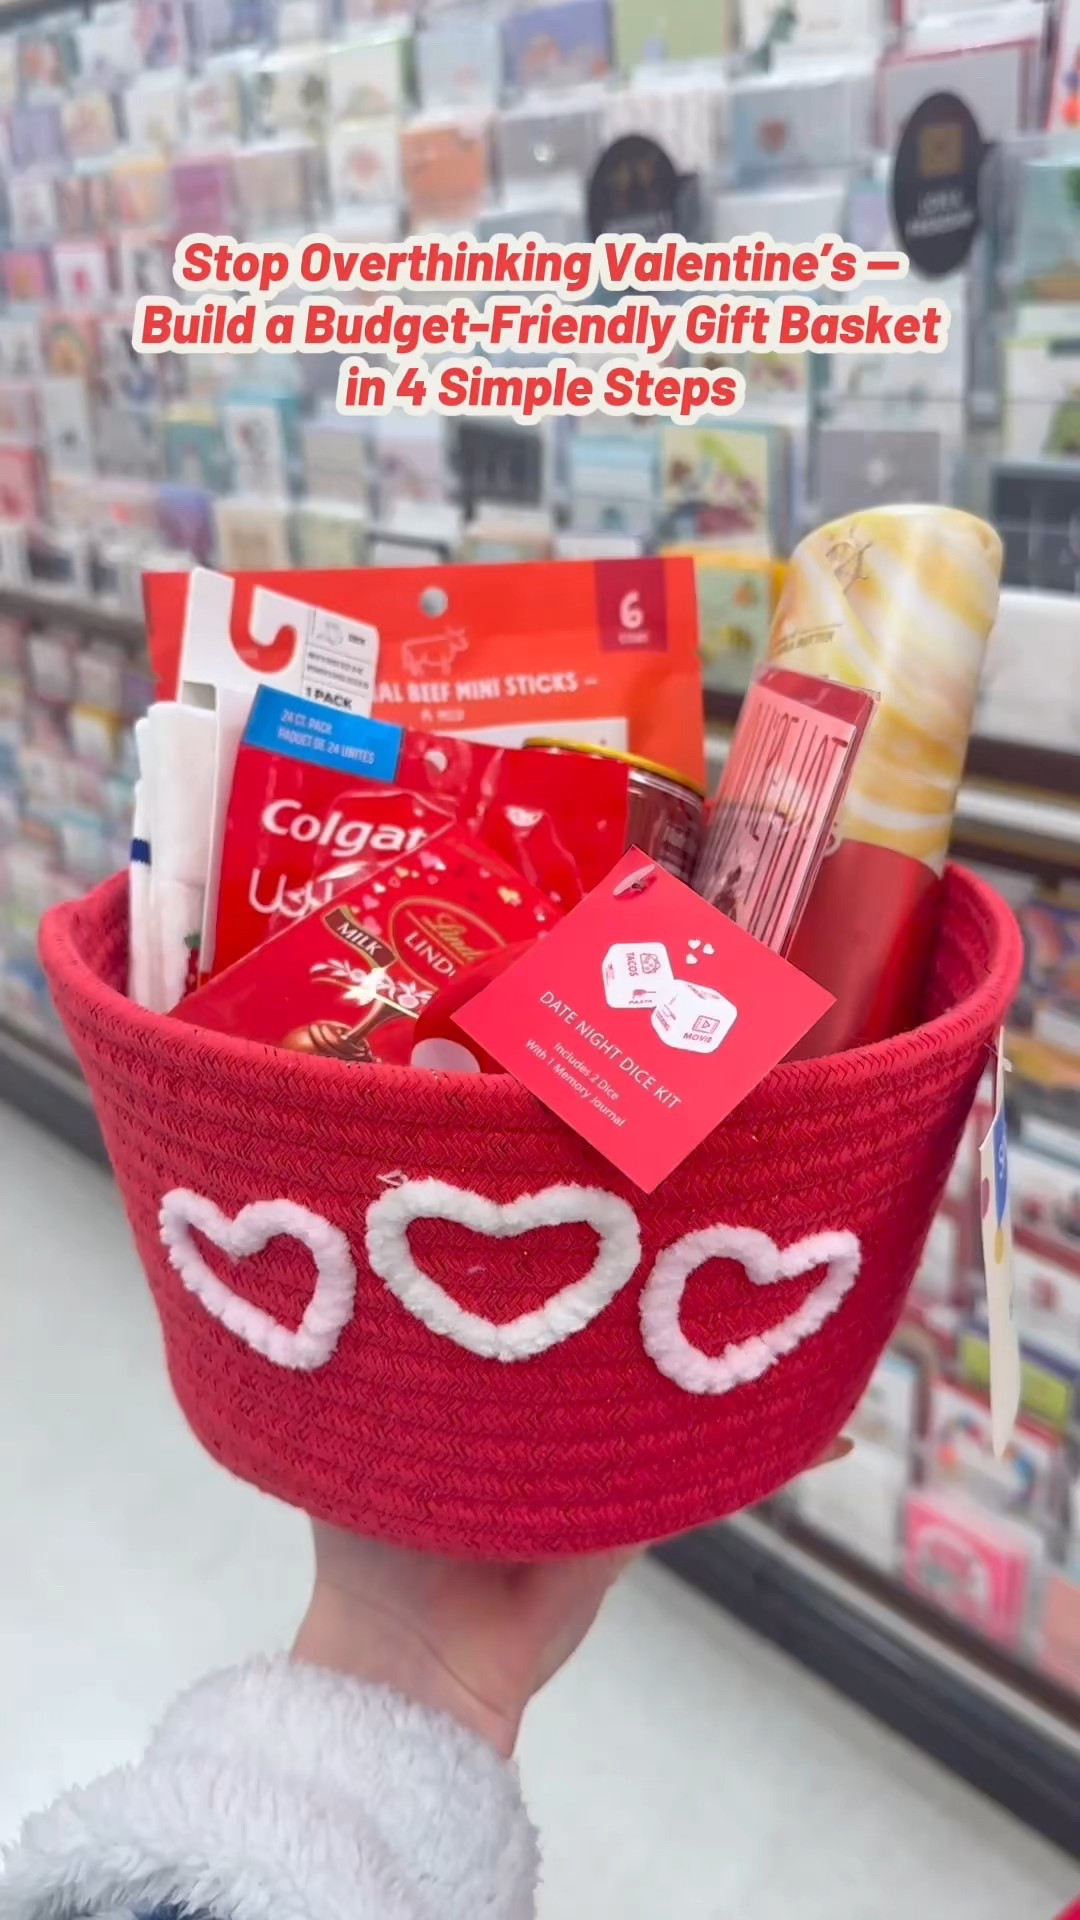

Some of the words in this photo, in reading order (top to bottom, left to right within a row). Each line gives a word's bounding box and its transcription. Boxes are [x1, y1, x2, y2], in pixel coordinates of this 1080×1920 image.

[619, 589, 644, 629] 6
[315, 688, 353, 711] PACK
[407, 681, 450, 704] BEEF
[456, 677, 500, 702] MINI
[504, 670, 578, 697] STICKS
[281, 708, 295, 723] 24
[261, 799, 428, 857] Colgat
[337, 921, 384, 956] MILK
[626, 952, 639, 977] TACOS
[539, 991, 579, 1025] DATE
[575, 1020, 623, 1060] NIGHT
[619, 1057, 657, 1090] DICE
[653, 1085, 682, 1109] KIT
[682, 1032, 712, 1043] MOVIE
[553, 1042, 592, 1077] Includes
[589, 1073, 600, 1084] 2
[597, 1079, 620, 1101] Dice
[553, 1063, 593, 1099] Memory
[589, 1095, 627, 1128] Journal
